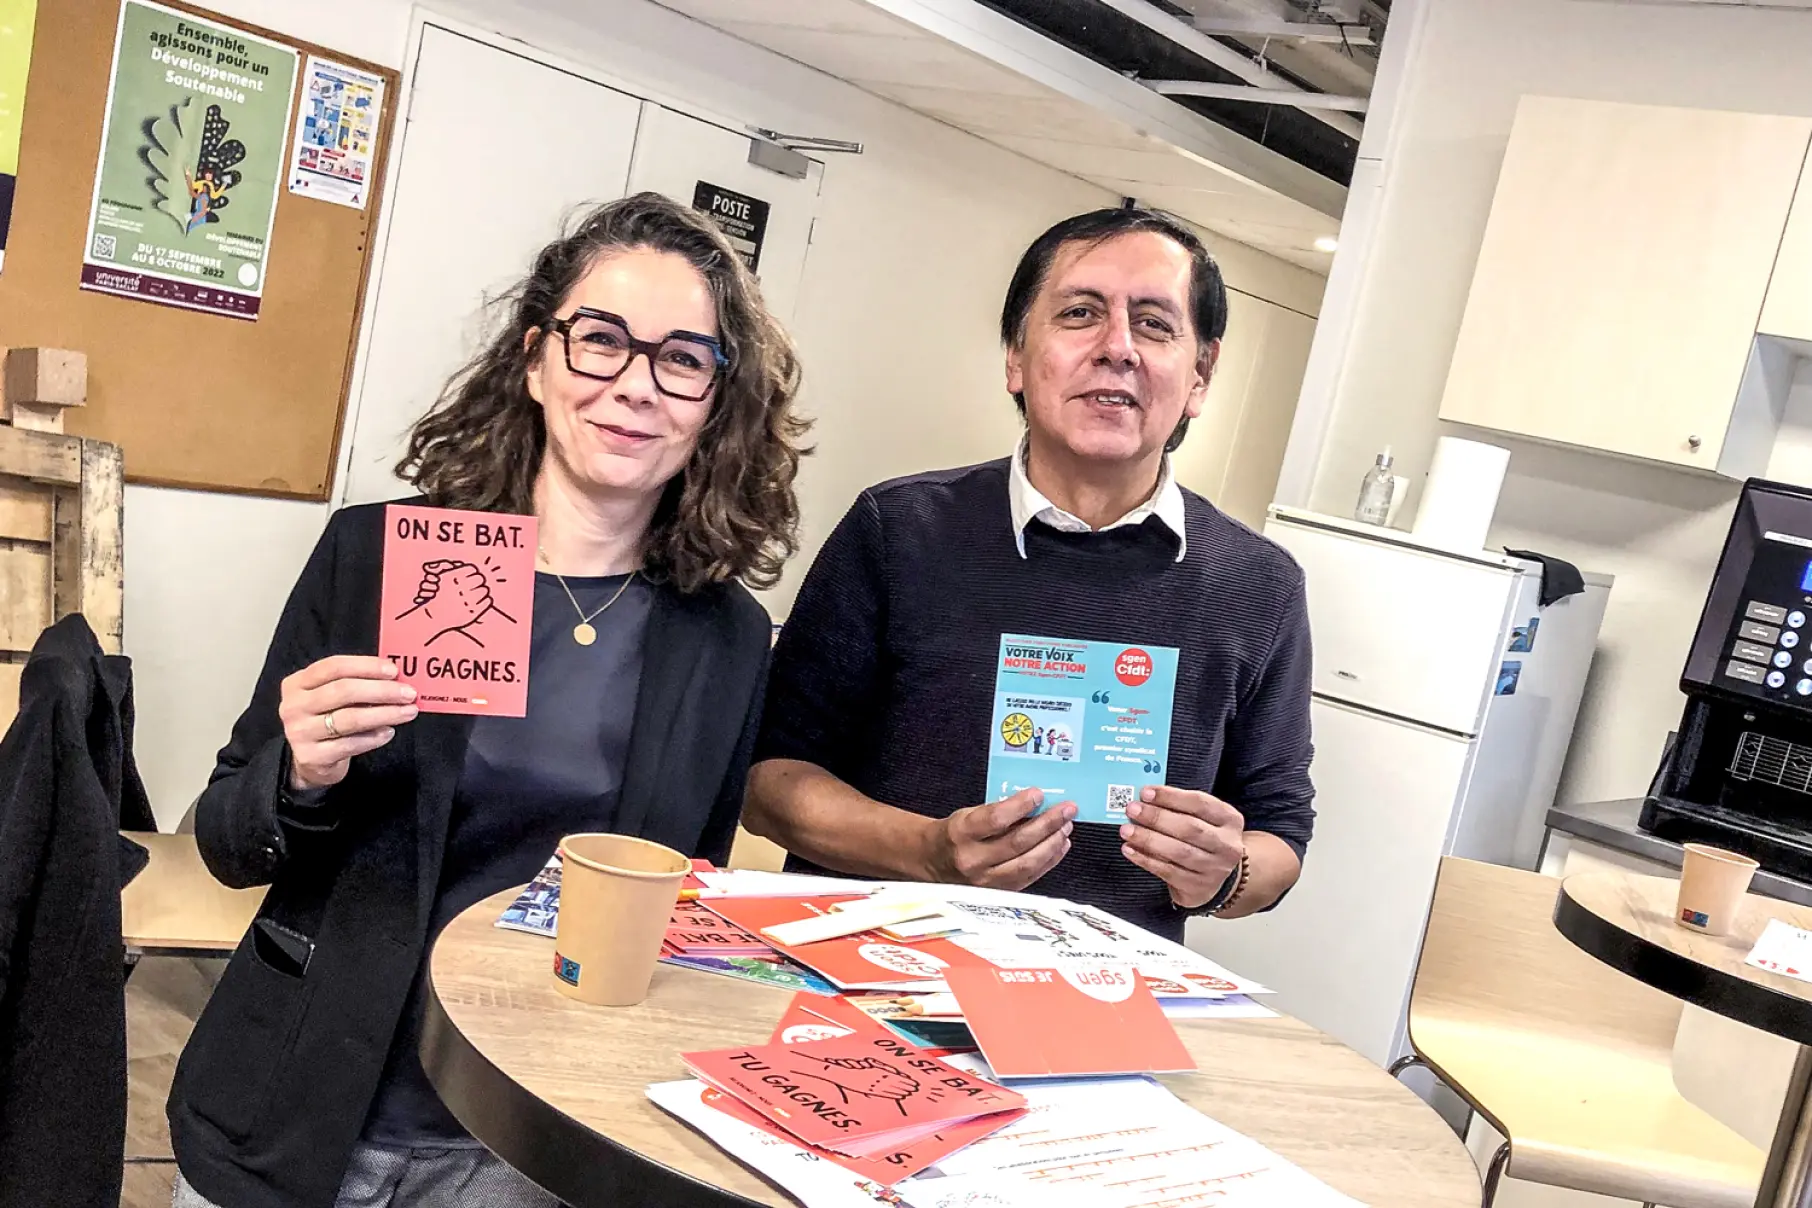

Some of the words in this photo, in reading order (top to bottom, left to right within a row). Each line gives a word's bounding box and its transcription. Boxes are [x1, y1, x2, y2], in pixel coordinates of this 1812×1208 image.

[150, 31, 212, 58] agissons
[216, 51, 249, 69] pour
[252, 62, 269, 75] un
[177, 22, 249, 57] Ensemble,
[151, 47, 264, 92] Développement
[165, 69, 245, 104] Soutenable
[712, 195, 751, 220] POSTE
[131, 252, 147, 263] AU
[156, 257, 201, 274] OCTOBRE
[203, 266, 225, 279] 2022
[138, 243, 153, 254] DU
[155, 247, 167, 257] 17
[168, 249, 222, 269] SEPTEMBRE
[96, 272, 142, 286] université
[397, 518, 429, 540] ON
[437, 521, 465, 543] SE
[475, 524, 525, 549] BAT.
[1004, 657, 1041, 669] NOTRE
[1044, 662, 1087, 673] ACTION
[1006, 647, 1043, 659] VOTRE
[1045, 647, 1075, 662] VOIX
[1122, 654, 1147, 664] sgen
[387, 655, 417, 677] TU
[426, 657, 521, 683] GAGNES.
[672, 933, 731, 944] BAT.
[1076, 970, 1125, 986] sgen
[874, 1039, 916, 1057] ON
[907, 1060, 947, 1075] SE
[940, 1077, 1003, 1105] BAT.
[729, 1052, 771, 1071] TU
[762, 1074, 862, 1132] GAGNES.
